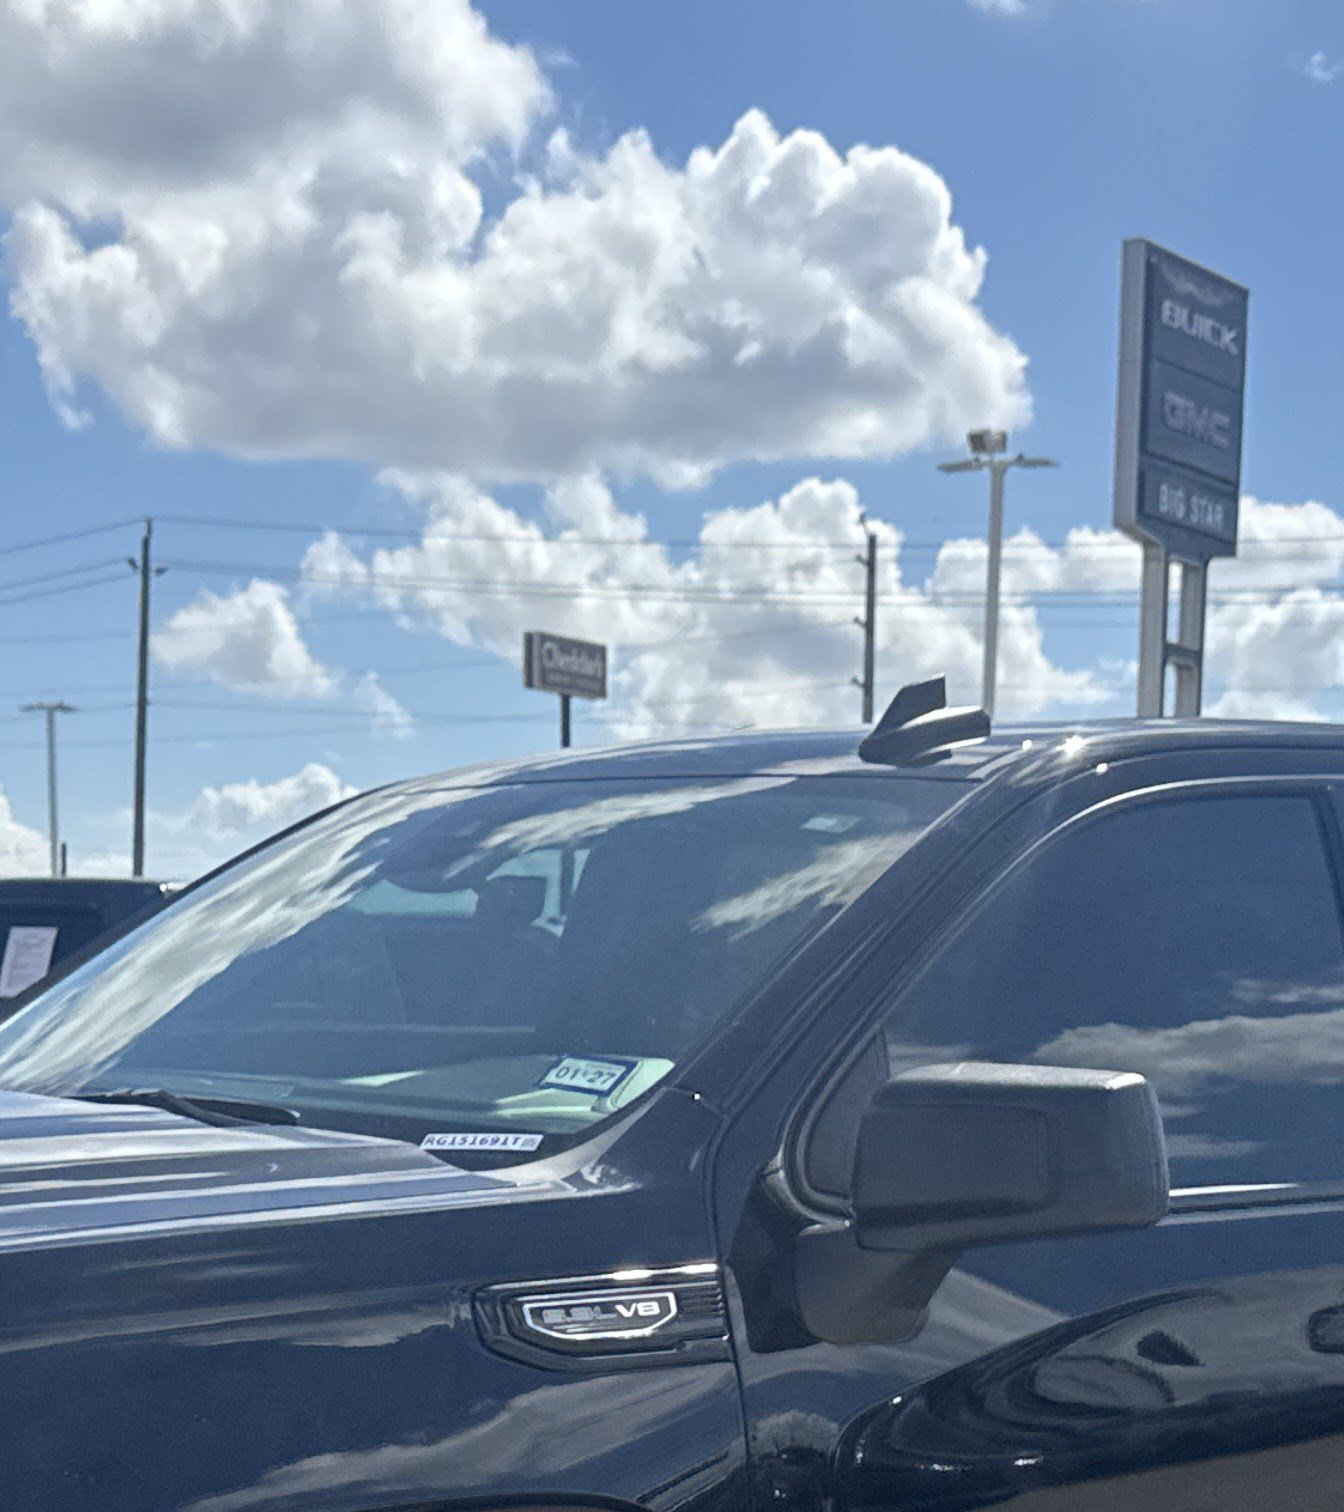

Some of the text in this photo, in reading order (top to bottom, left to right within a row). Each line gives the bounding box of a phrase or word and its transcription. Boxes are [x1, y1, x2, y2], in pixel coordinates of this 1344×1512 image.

[1161, 299, 1238, 355] BUICK
[1163, 391, 1231, 450] GMC
[615, 1301, 661, 1318] V8
